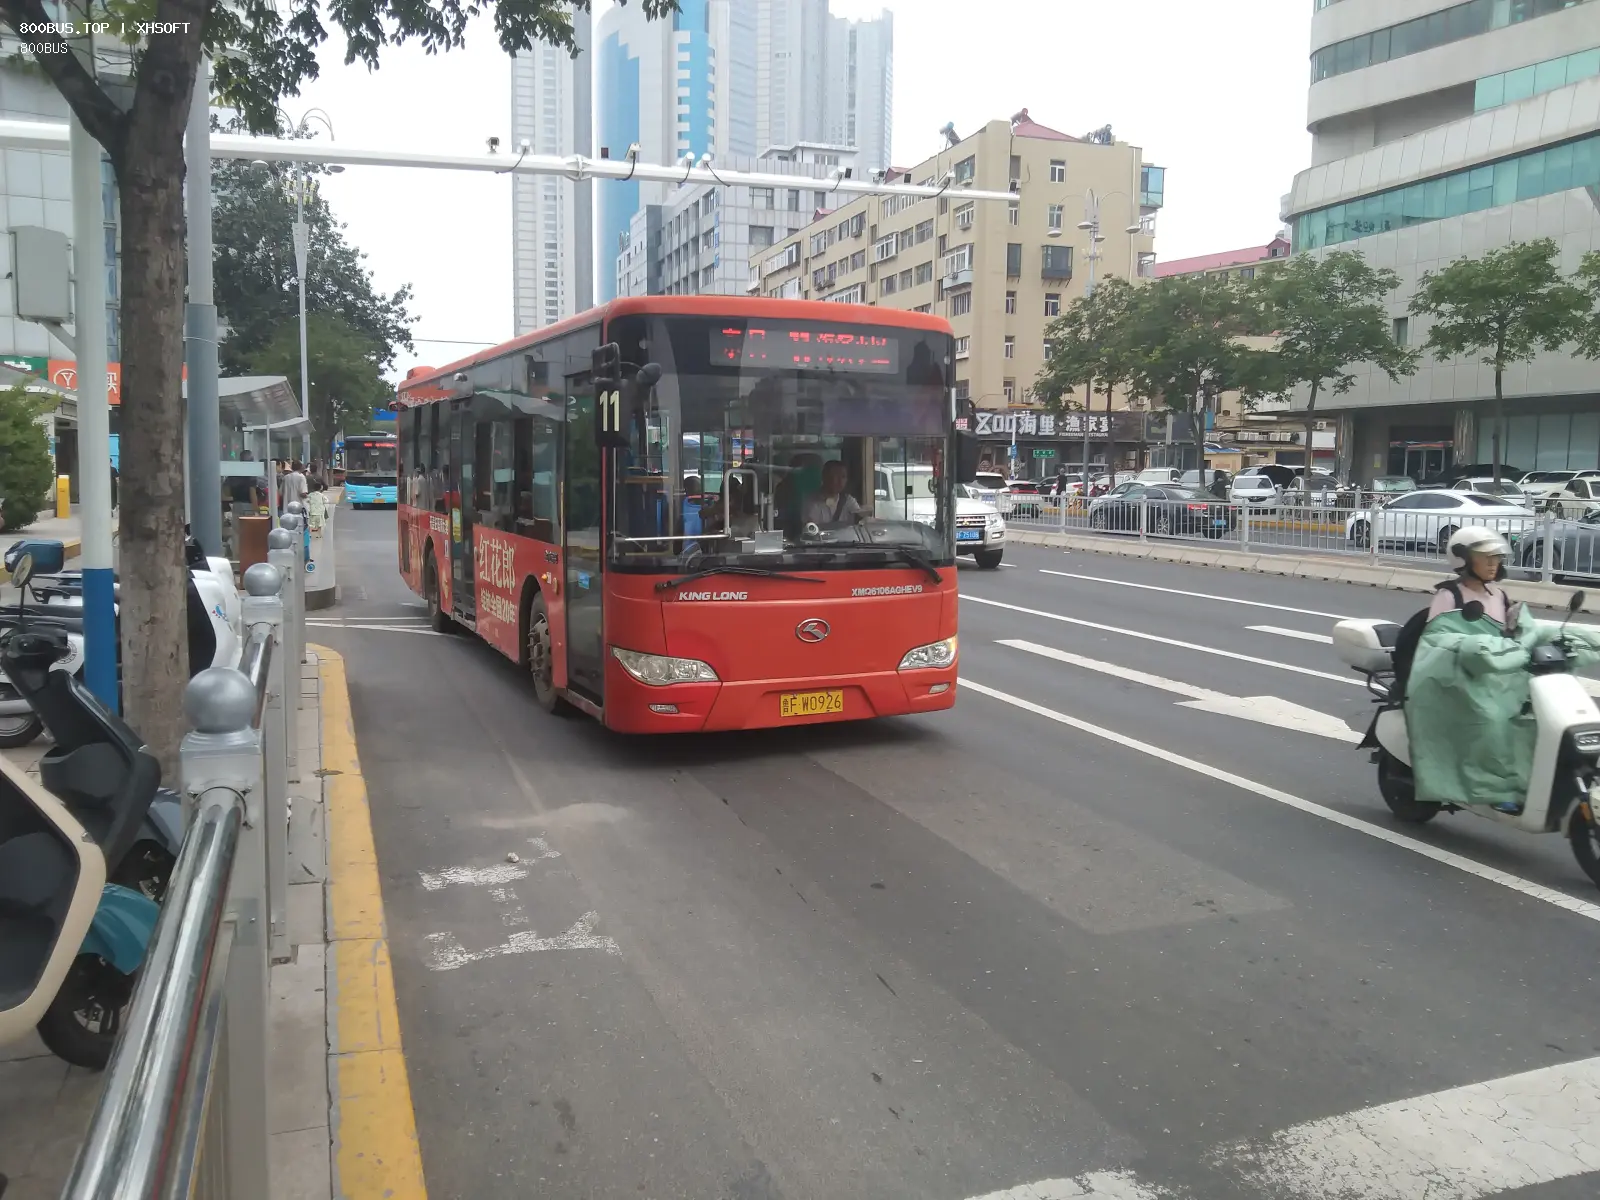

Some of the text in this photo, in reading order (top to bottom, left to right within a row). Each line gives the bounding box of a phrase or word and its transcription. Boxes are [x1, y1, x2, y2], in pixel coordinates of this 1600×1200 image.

[600, 390, 620, 431] 11
[479, 534, 516, 594] 红花郎
[679, 592, 748, 601] KING LONG
[852, 585, 923, 596] XMQ6106AGHEV9
